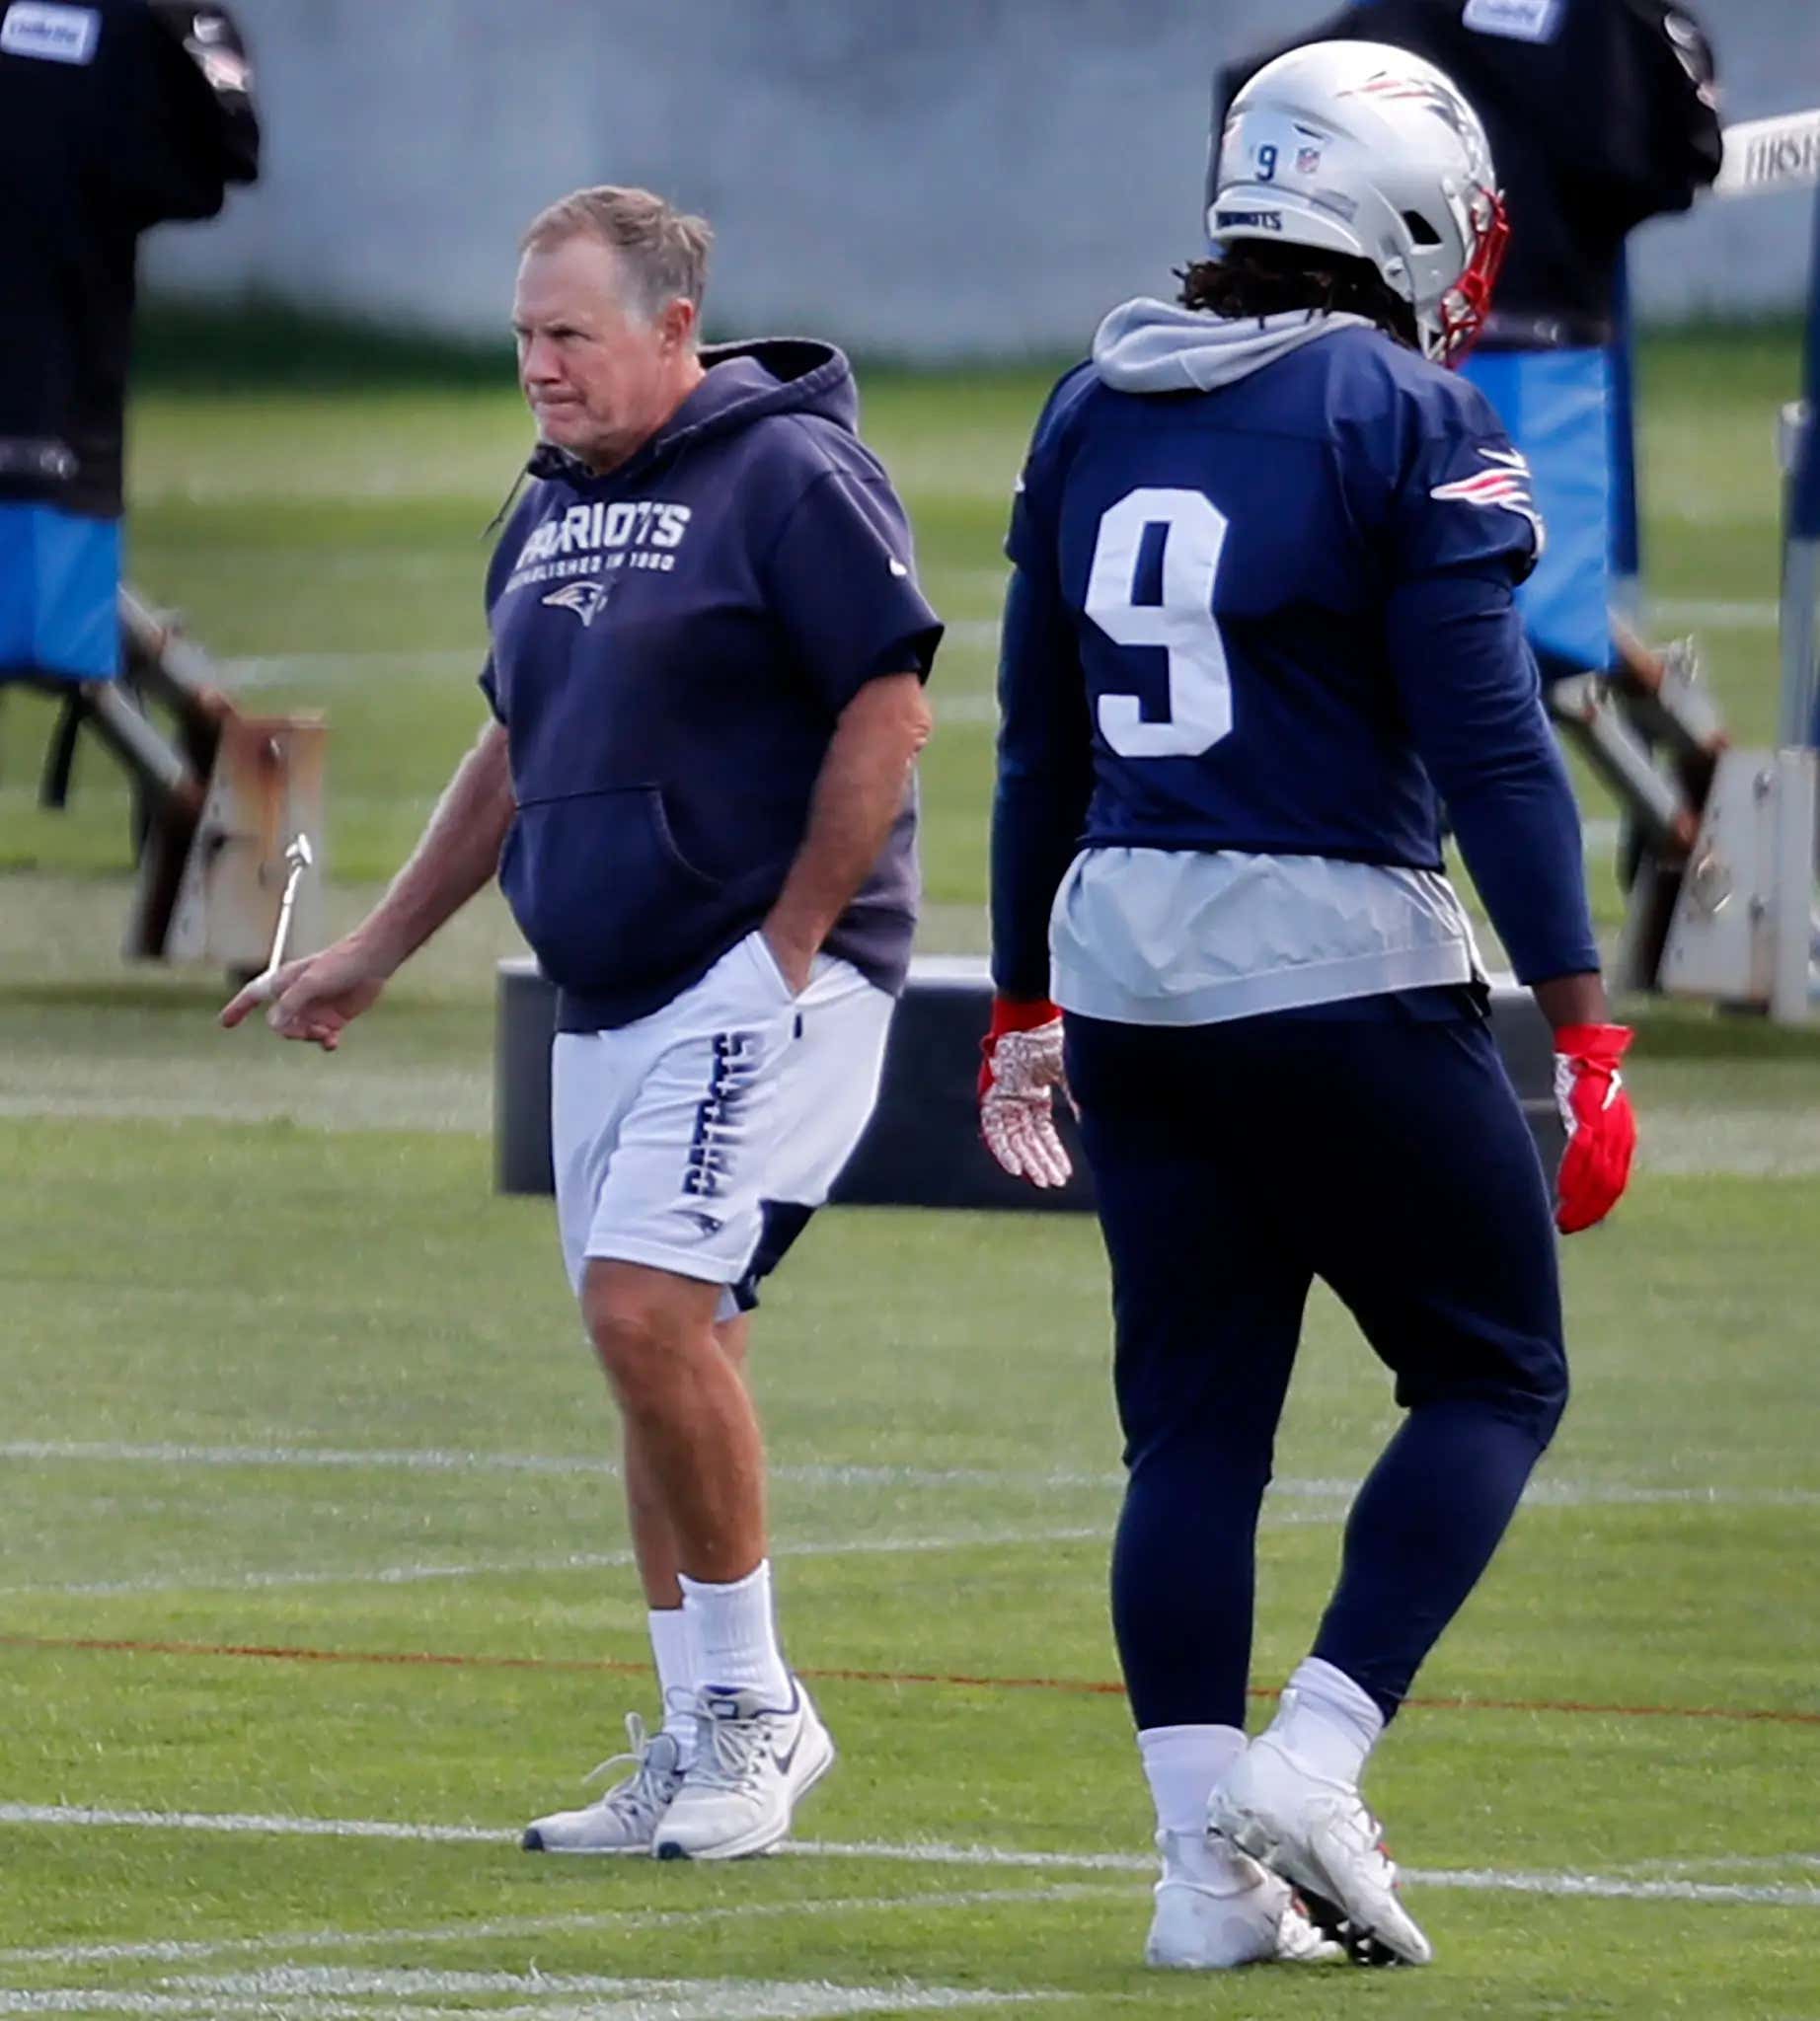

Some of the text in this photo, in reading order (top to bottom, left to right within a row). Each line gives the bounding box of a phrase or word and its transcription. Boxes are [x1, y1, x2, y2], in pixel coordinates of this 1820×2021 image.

[1256, 145, 1278, 182] 9
[504, 554, 602, 593] ABLISHED
[1084, 487, 1233, 759] 9
